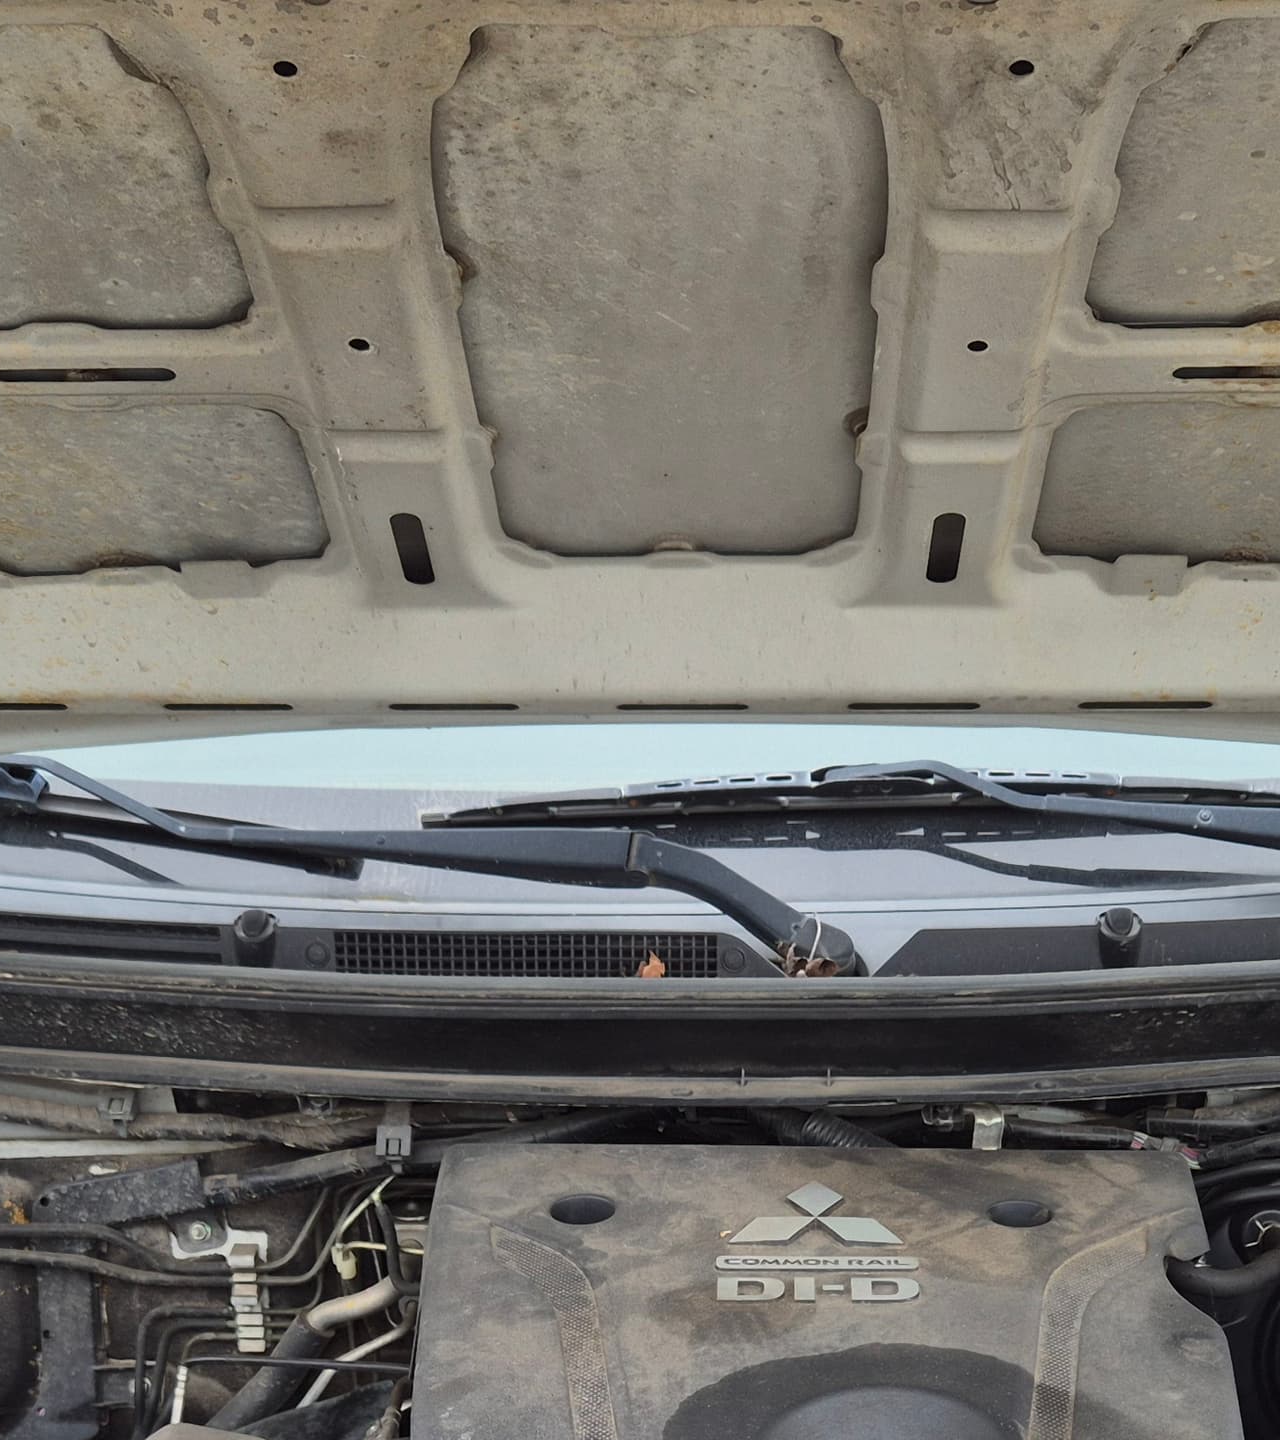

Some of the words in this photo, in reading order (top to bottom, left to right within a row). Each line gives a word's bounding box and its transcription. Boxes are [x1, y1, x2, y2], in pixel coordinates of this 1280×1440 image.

[723, 1257, 840, 1267] COMMON
[847, 1257, 913, 1267] RAIL
[716, 1276, 921, 1301] DI-D
